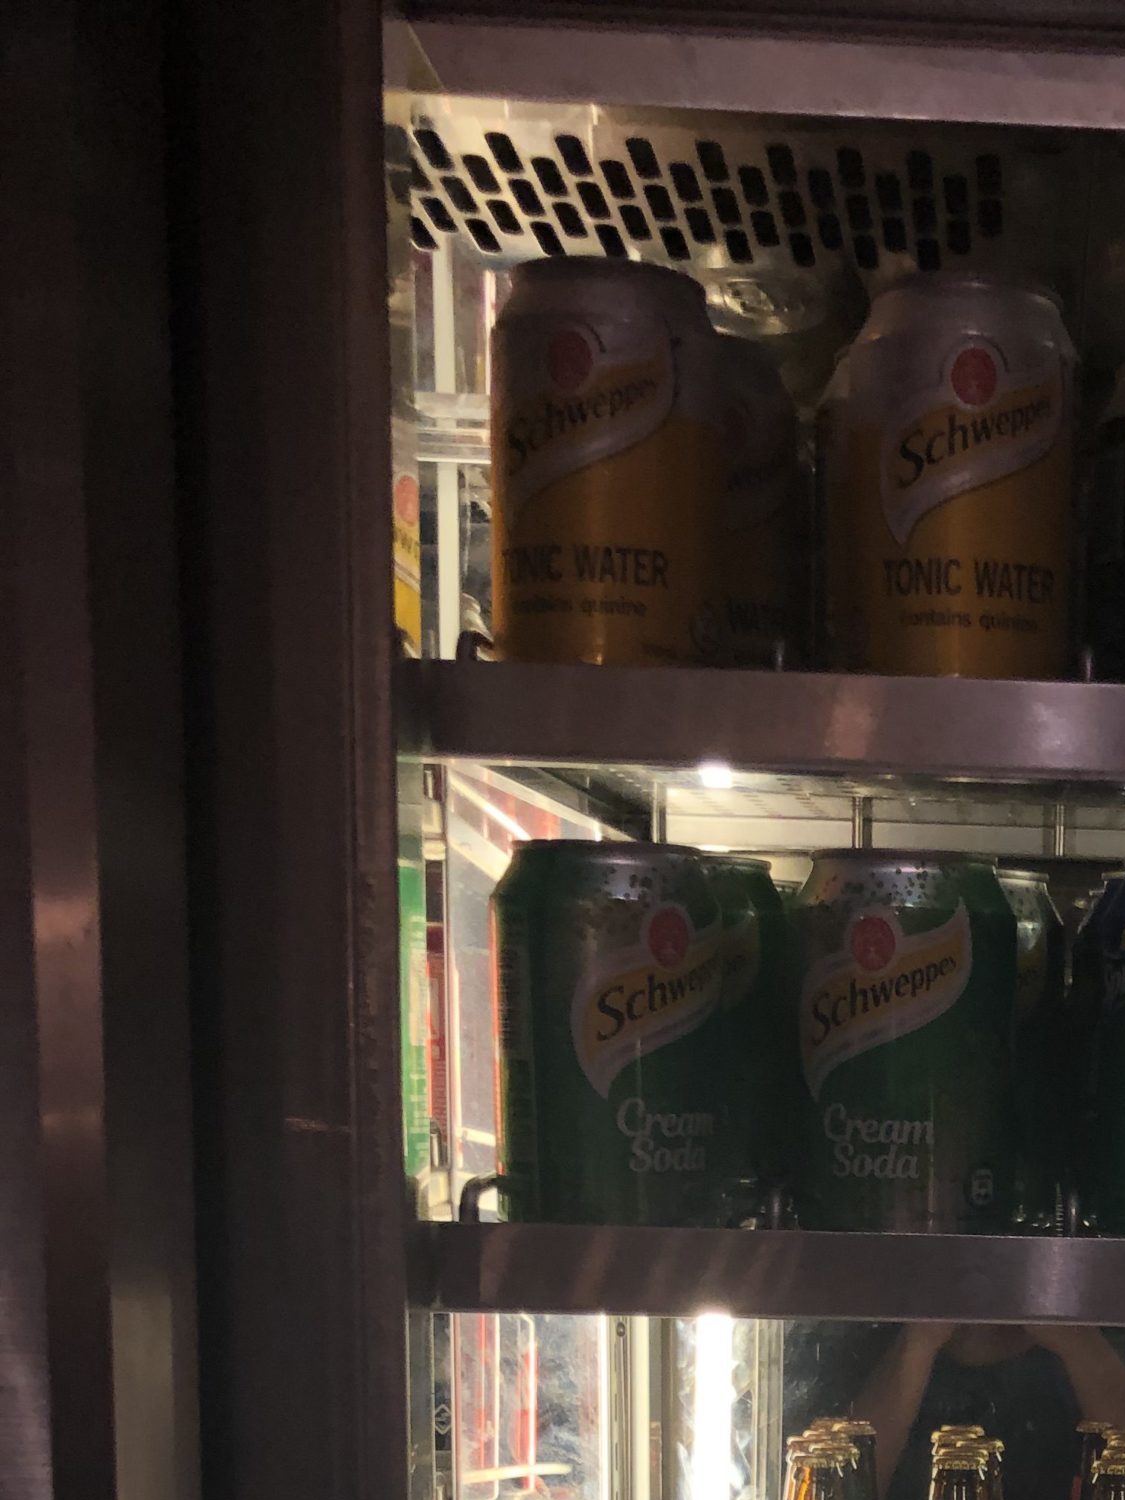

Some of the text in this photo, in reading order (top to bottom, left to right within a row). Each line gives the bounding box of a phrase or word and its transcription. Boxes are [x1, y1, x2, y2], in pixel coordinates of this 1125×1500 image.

[572, 544, 670, 590] WATER
[882, 556, 1056, 604] TONIC WATER
[811, 954, 957, 1048] Schweppes
[823, 1102, 935, 1145] Cream
[832, 1142, 920, 1179] Soda
